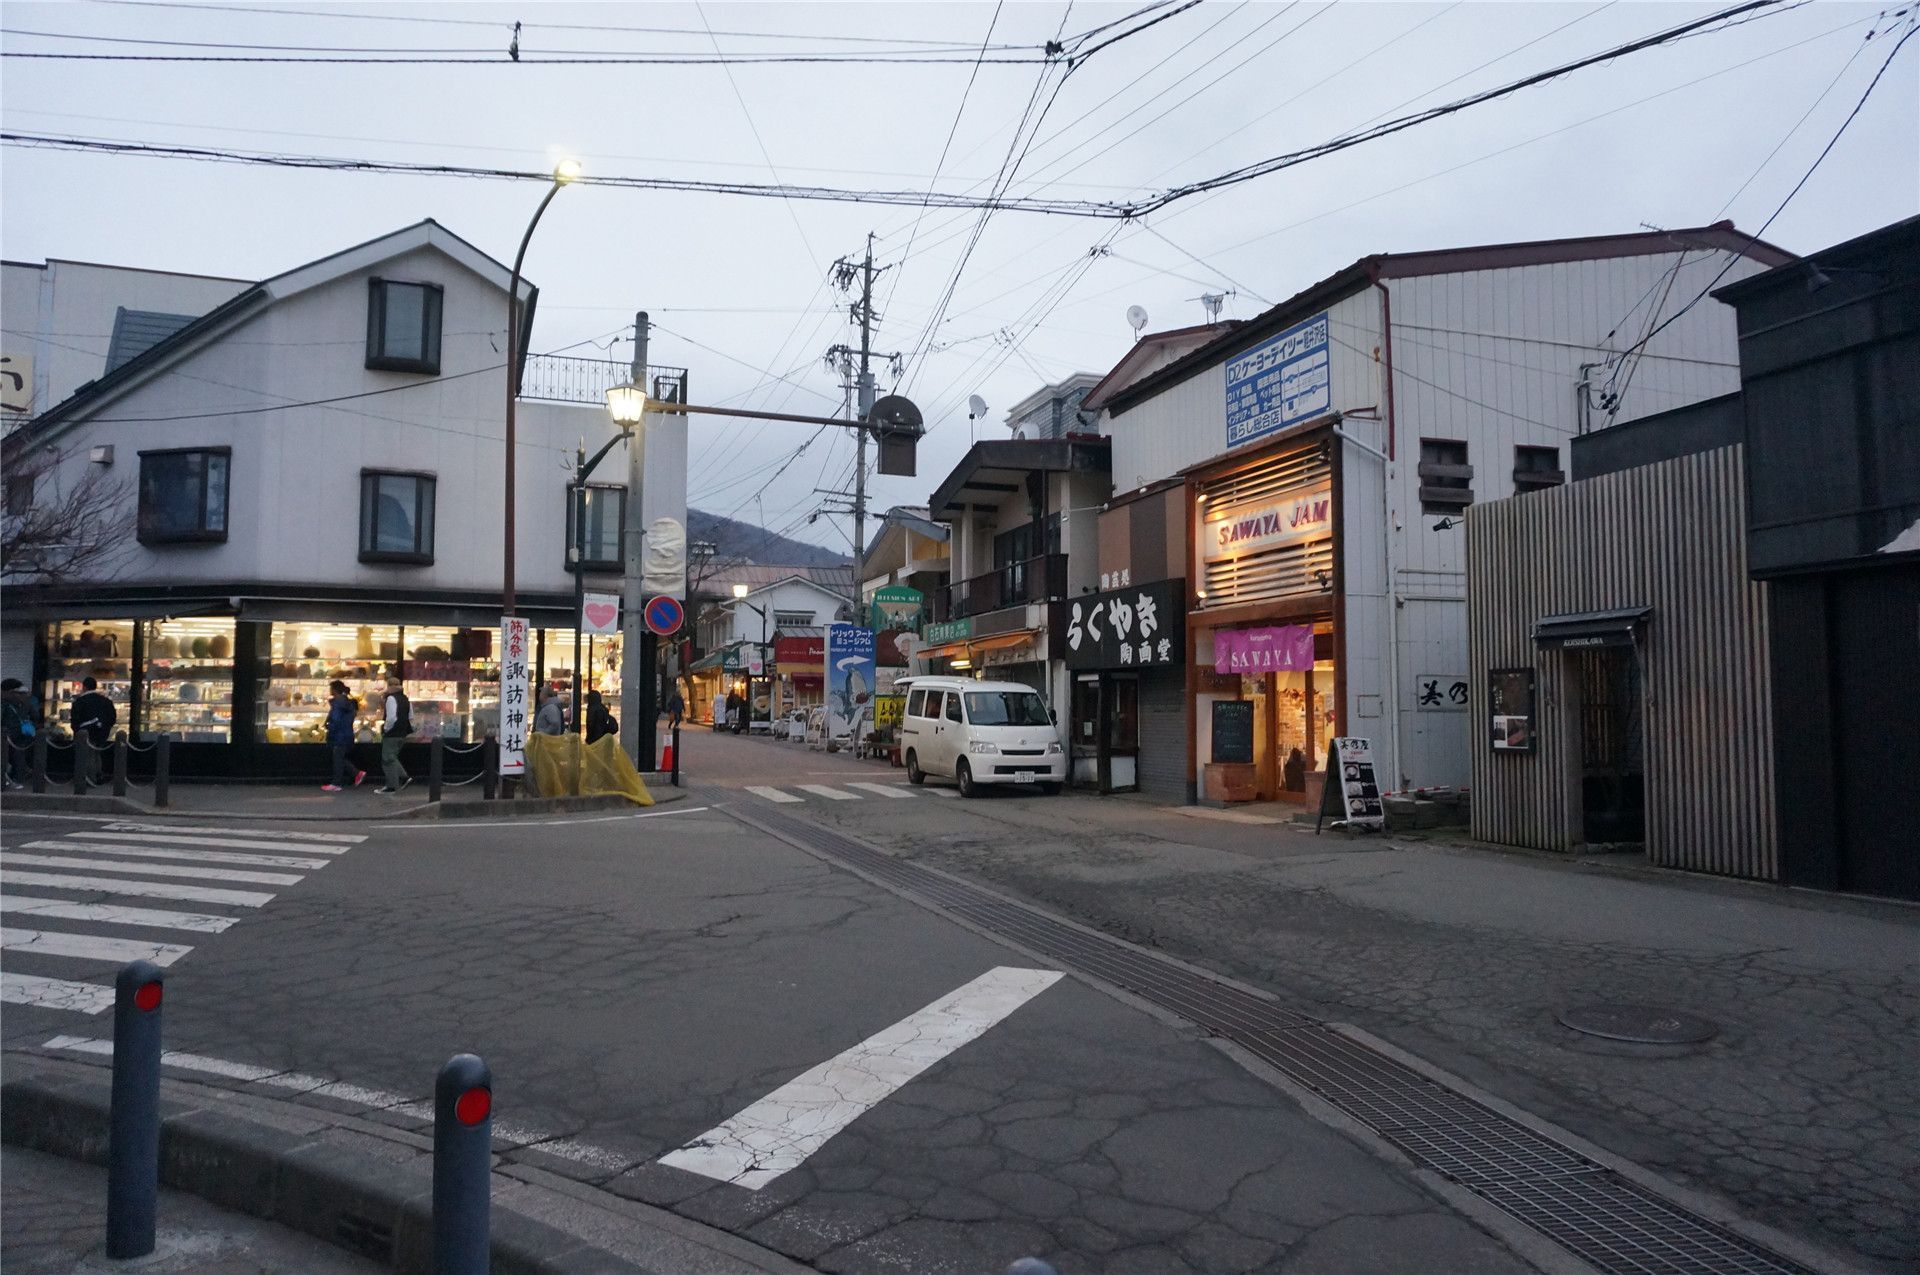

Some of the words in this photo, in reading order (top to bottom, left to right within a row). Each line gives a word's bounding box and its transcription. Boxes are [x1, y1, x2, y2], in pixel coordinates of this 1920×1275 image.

[1218, 512, 1282, 545] SAWAYA
[1291, 500, 1329, 528] JAM
[831, 629, 854, 637] トリック
[856, 629, 873, 637] アート
[1067, 593, 1158, 651] らくやき
[837, 637, 871, 645] ミュージアム
[1231, 649, 1292, 667] SAWAYA
[506, 661, 526, 753] 諏訪神社
